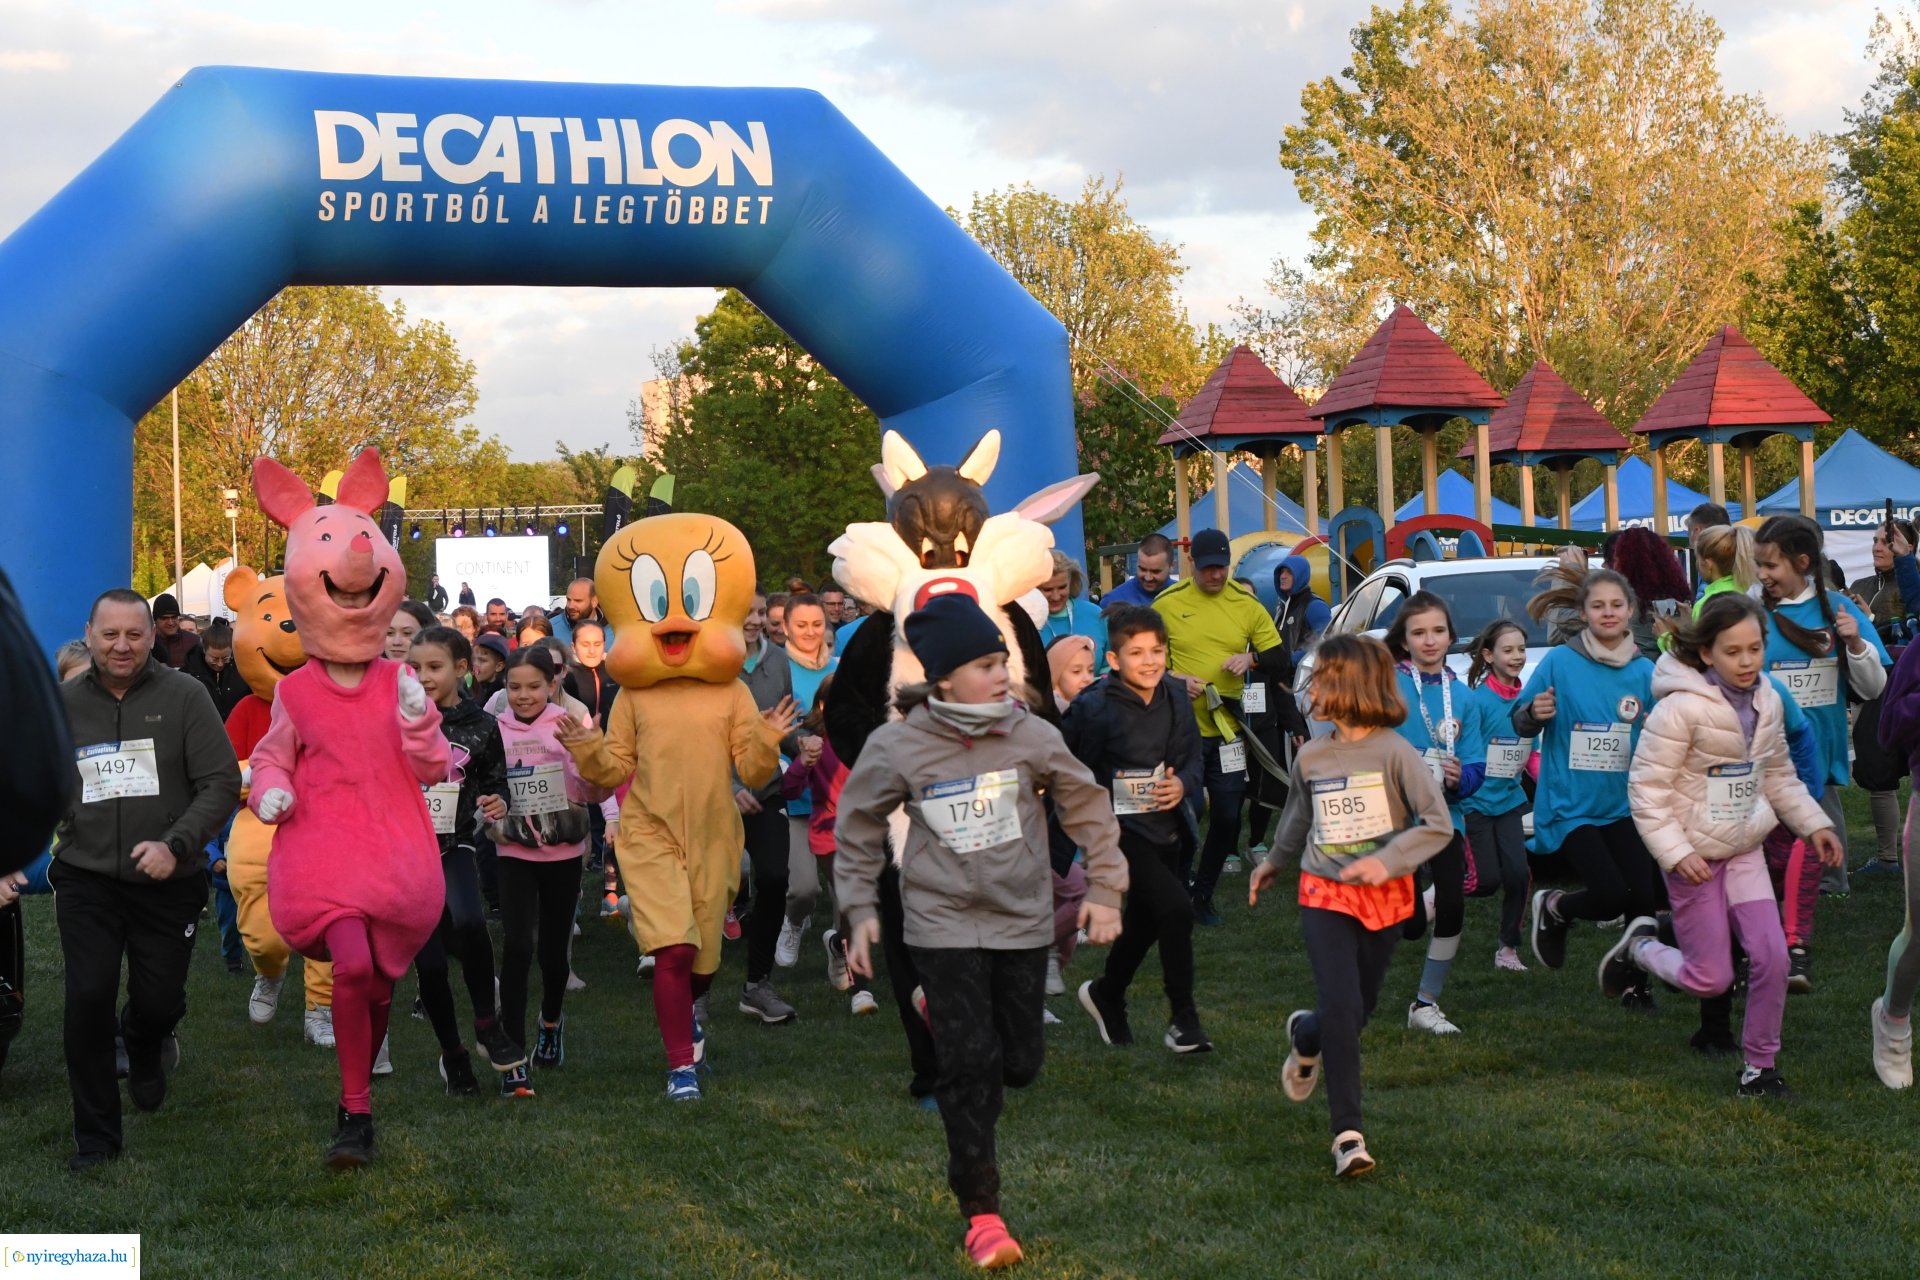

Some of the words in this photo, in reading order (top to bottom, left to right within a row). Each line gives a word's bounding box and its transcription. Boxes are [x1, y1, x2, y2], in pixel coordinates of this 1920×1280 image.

[313, 109, 773, 187] DECATHLON
[318, 187, 509, 224] SPORTBÓL
[532, 195, 549, 224] A
[574, 188, 773, 225] LEGTÖBBET
[456, 561, 531, 576] CONTINENT
[1787, 673, 1821, 688] 1577
[1586, 737, 1620, 752] 1252
[1502, 749, 1524, 761] 1581
[94, 758, 136, 776] 1497
[513, 779, 548, 796] 1758
[948, 797, 994, 823] 1791
[1321, 796, 1366, 817] 1585
